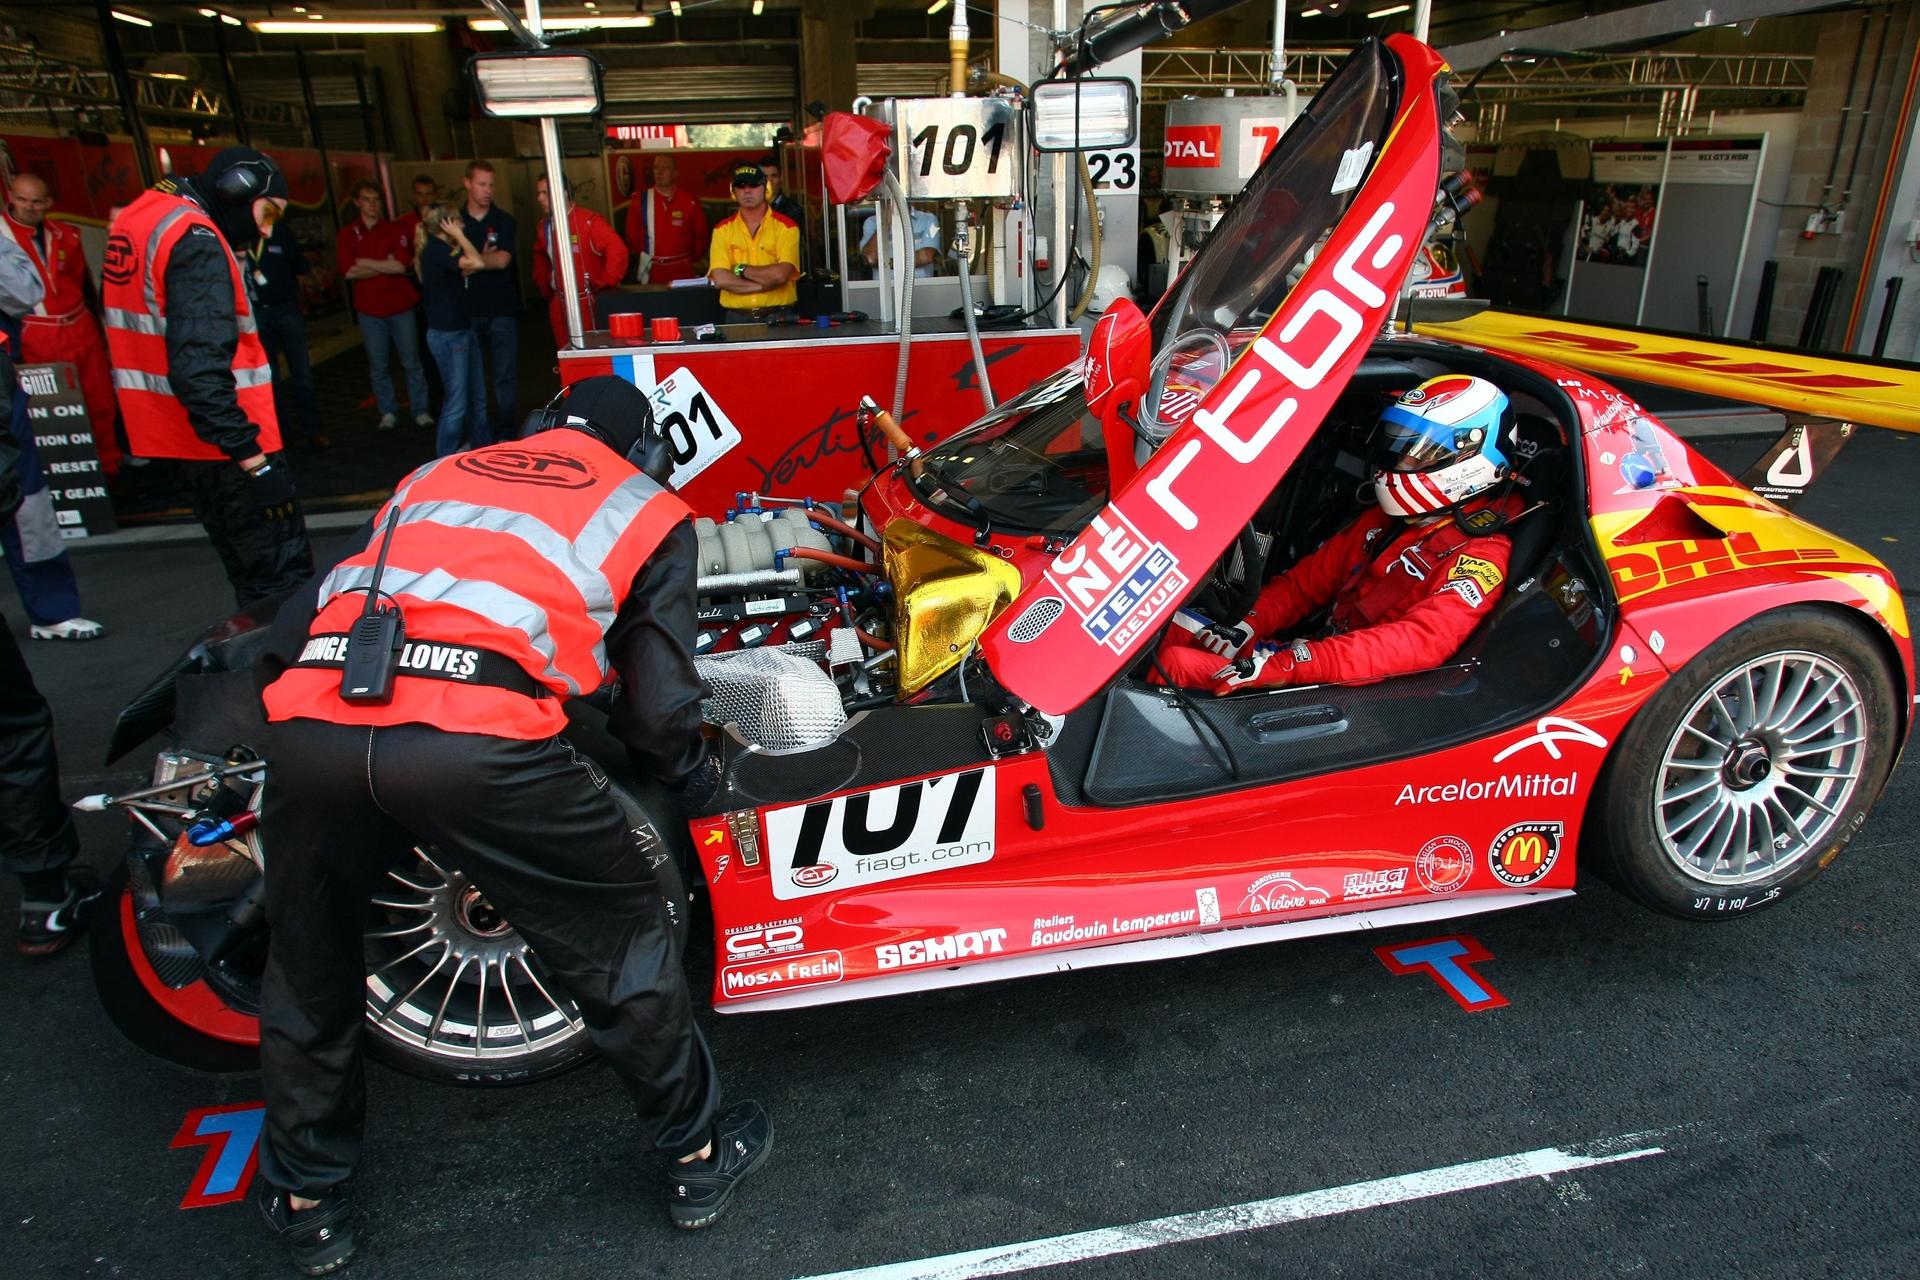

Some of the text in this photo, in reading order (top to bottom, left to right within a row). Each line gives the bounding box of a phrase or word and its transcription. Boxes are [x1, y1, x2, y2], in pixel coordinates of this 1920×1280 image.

[913, 122, 1005, 176] 101
[1164, 140, 1215, 158] OTAL
[1087, 153, 1136, 189] 23
[1418, 287, 1447, 299] MOTUL
[53, 404, 85, 417] ON
[661, 391, 723, 466] 01
[35, 433, 93, 448] TION ON
[51, 460, 99, 474] RESET
[65, 487, 107, 500] GEAR
[1606, 532, 1800, 605] DHL
[1089, 550, 1171, 632] TELE
[1113, 575, 1182, 645] REVUE
[1394, 772, 1577, 806] ArcelorMittal
[855, 839, 991, 874] fiagt.com
[1495, 849, 1555, 883] RACING TEAM
[1248, 872, 1291, 894] CARROSSERIE
[1344, 868, 1409, 889] ELLEGI
[725, 917, 803, 935] DESIGN & LETTRAGE
[1031, 908, 1196, 947] Baudouin Lempereur
[1033, 914, 1074, 929] Ateliers
[727, 942, 804, 961] DESIGNERS
